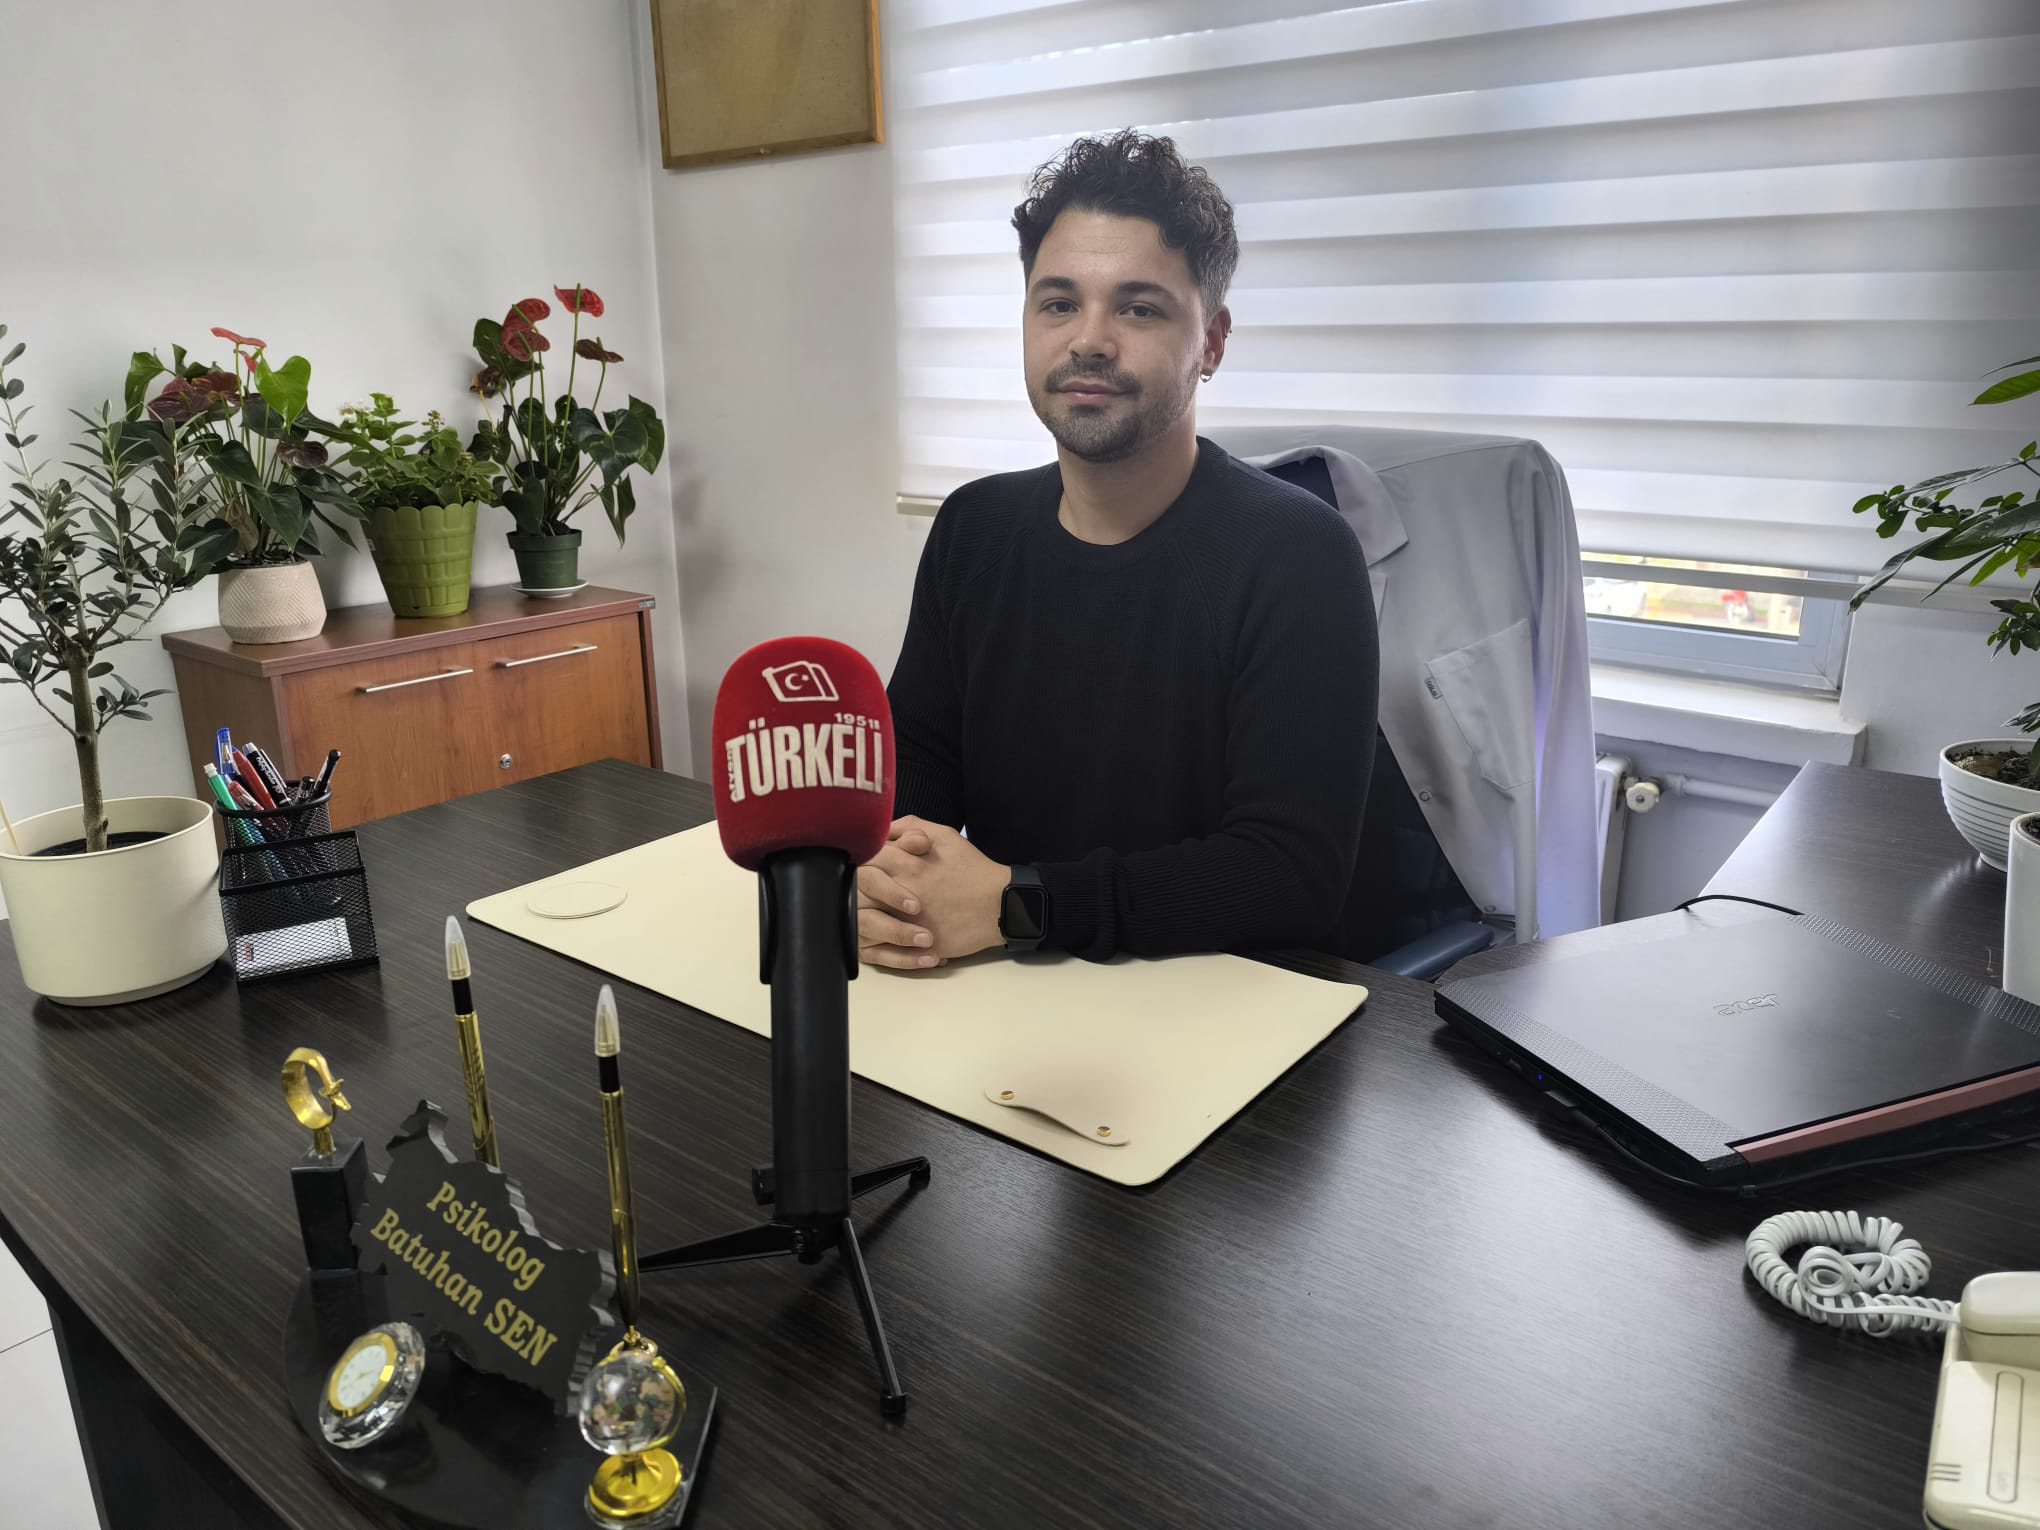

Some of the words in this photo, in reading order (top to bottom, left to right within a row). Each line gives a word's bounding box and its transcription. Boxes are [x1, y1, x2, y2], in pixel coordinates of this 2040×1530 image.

[1712, 993, 1780, 1015] acer
[370, 1208, 484, 1315] Batuhan
[483, 1298, 558, 1366] SEN
[426, 1181, 546, 1291] Psikolog
